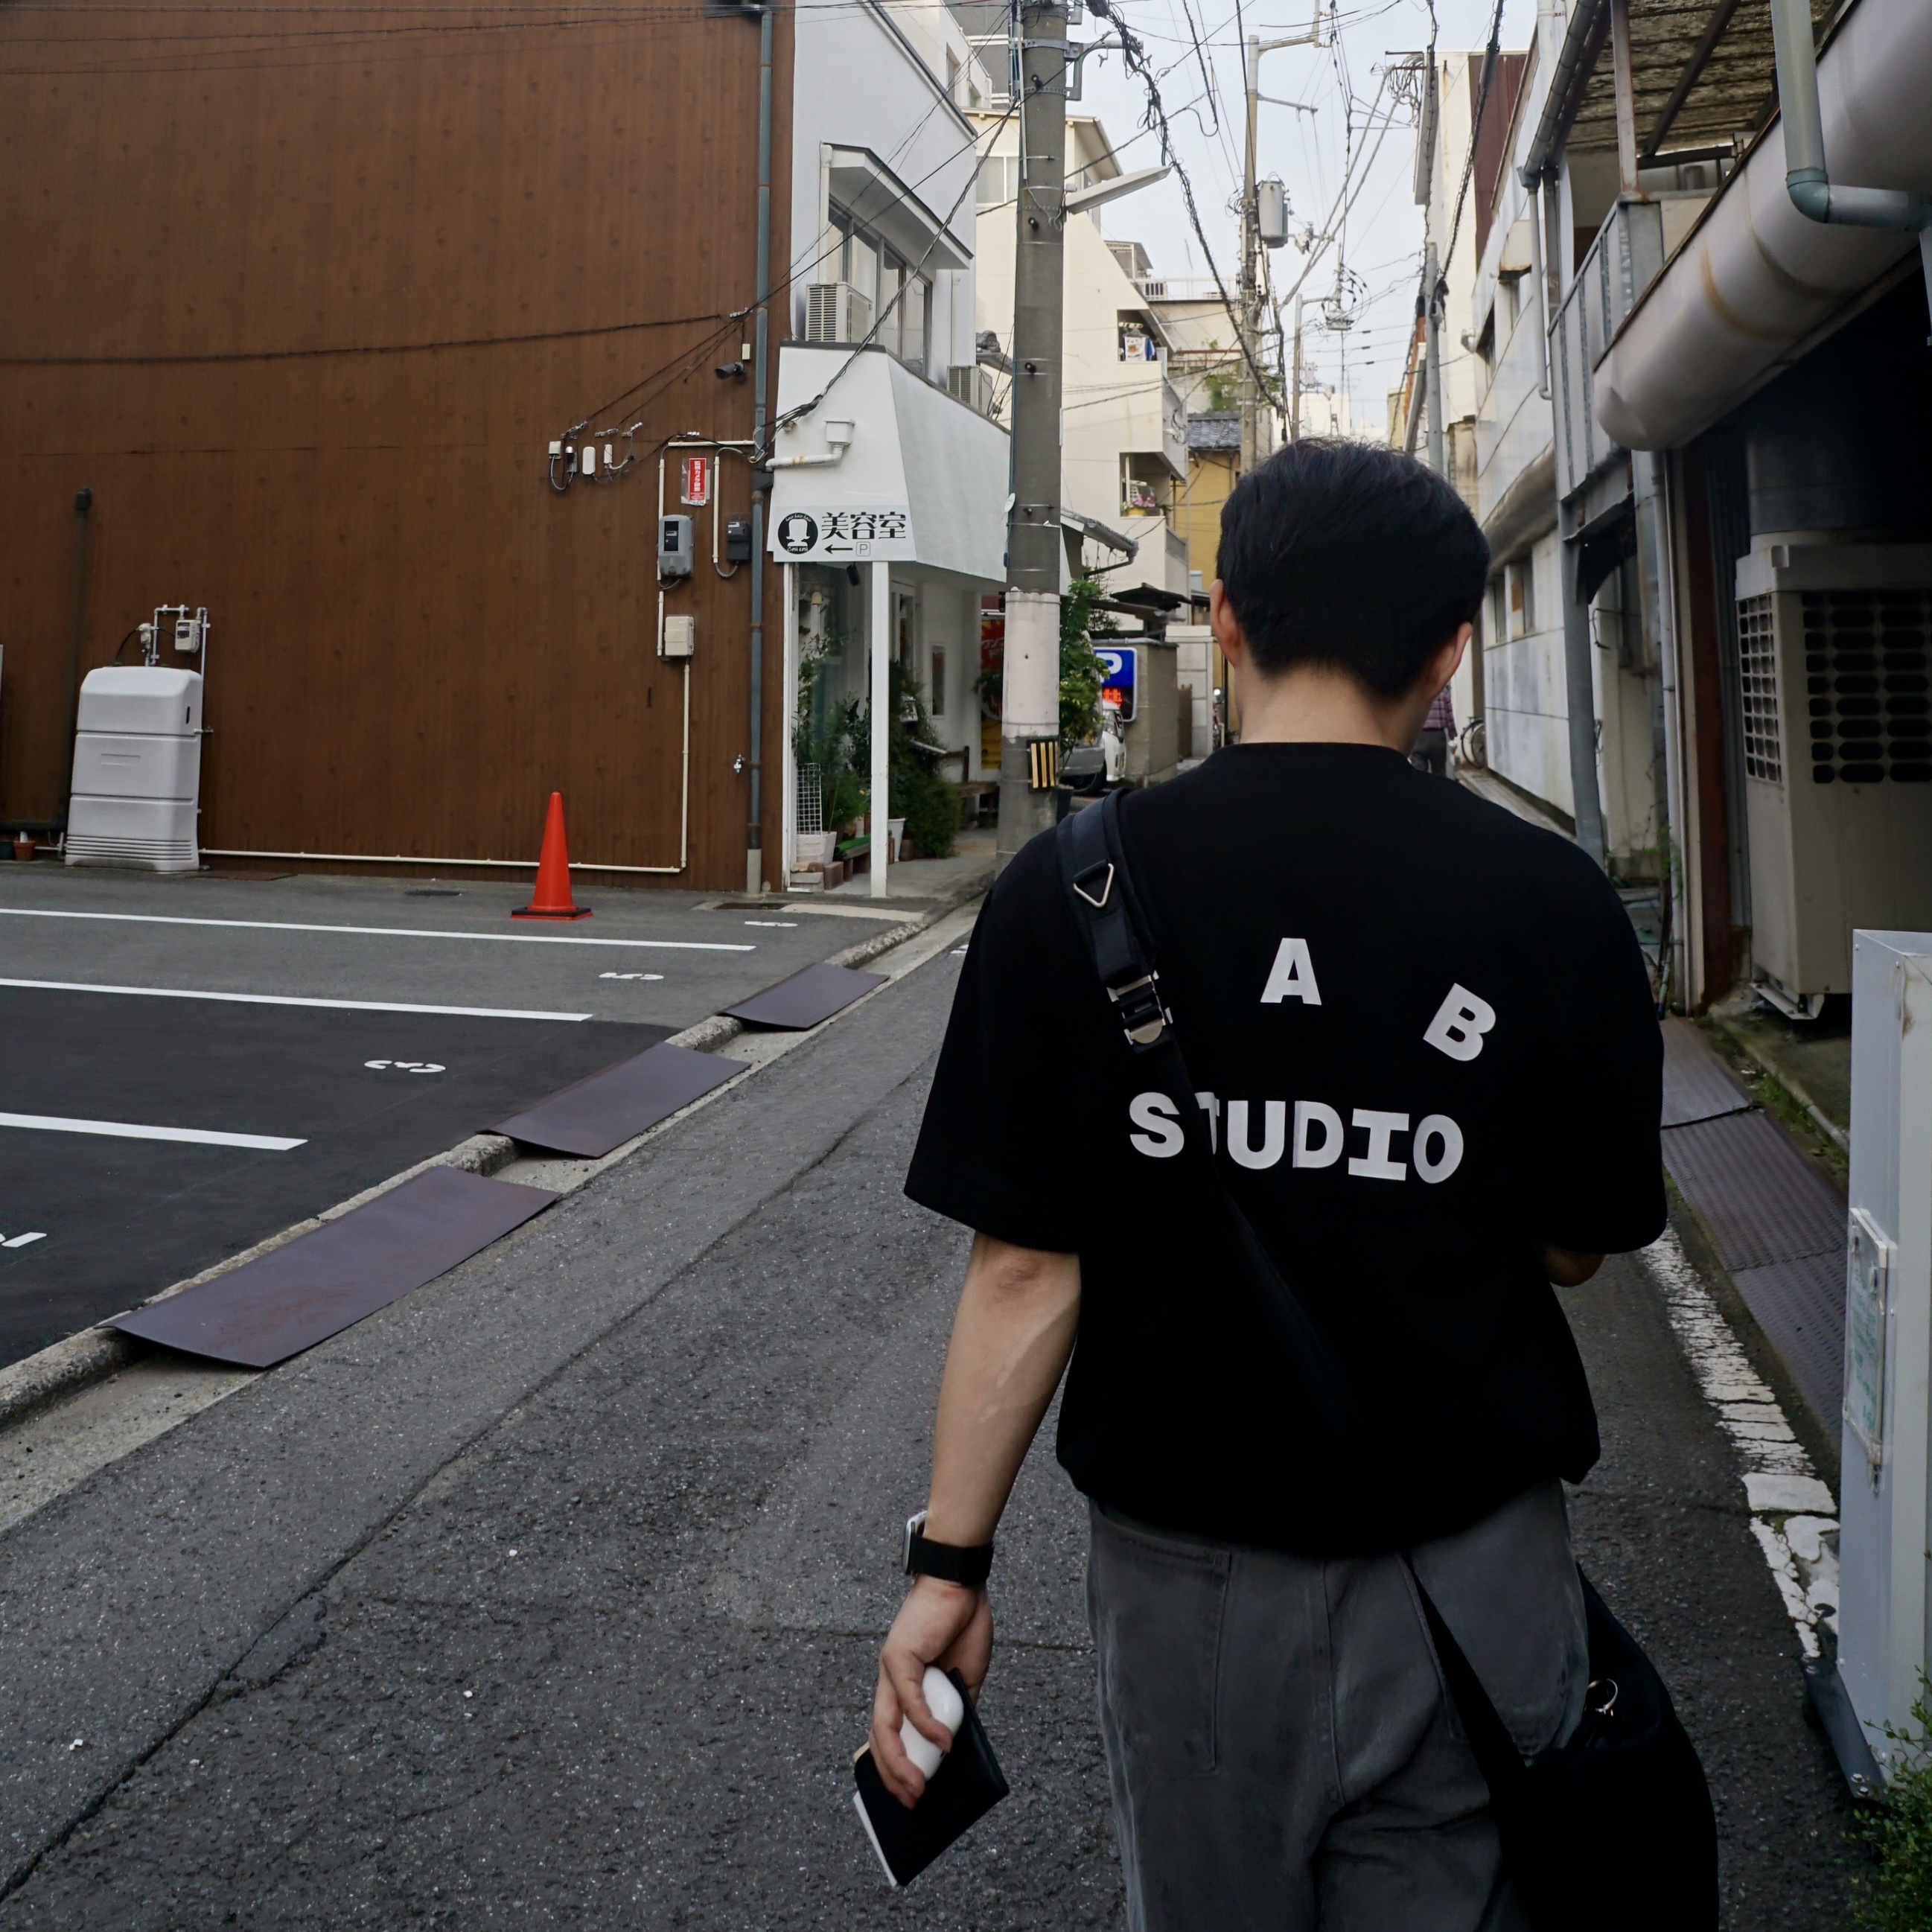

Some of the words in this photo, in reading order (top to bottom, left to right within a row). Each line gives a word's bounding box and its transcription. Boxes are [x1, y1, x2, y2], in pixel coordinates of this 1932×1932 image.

[821, 511, 906, 540] 美容室
[1095, 652, 1123, 683] P
